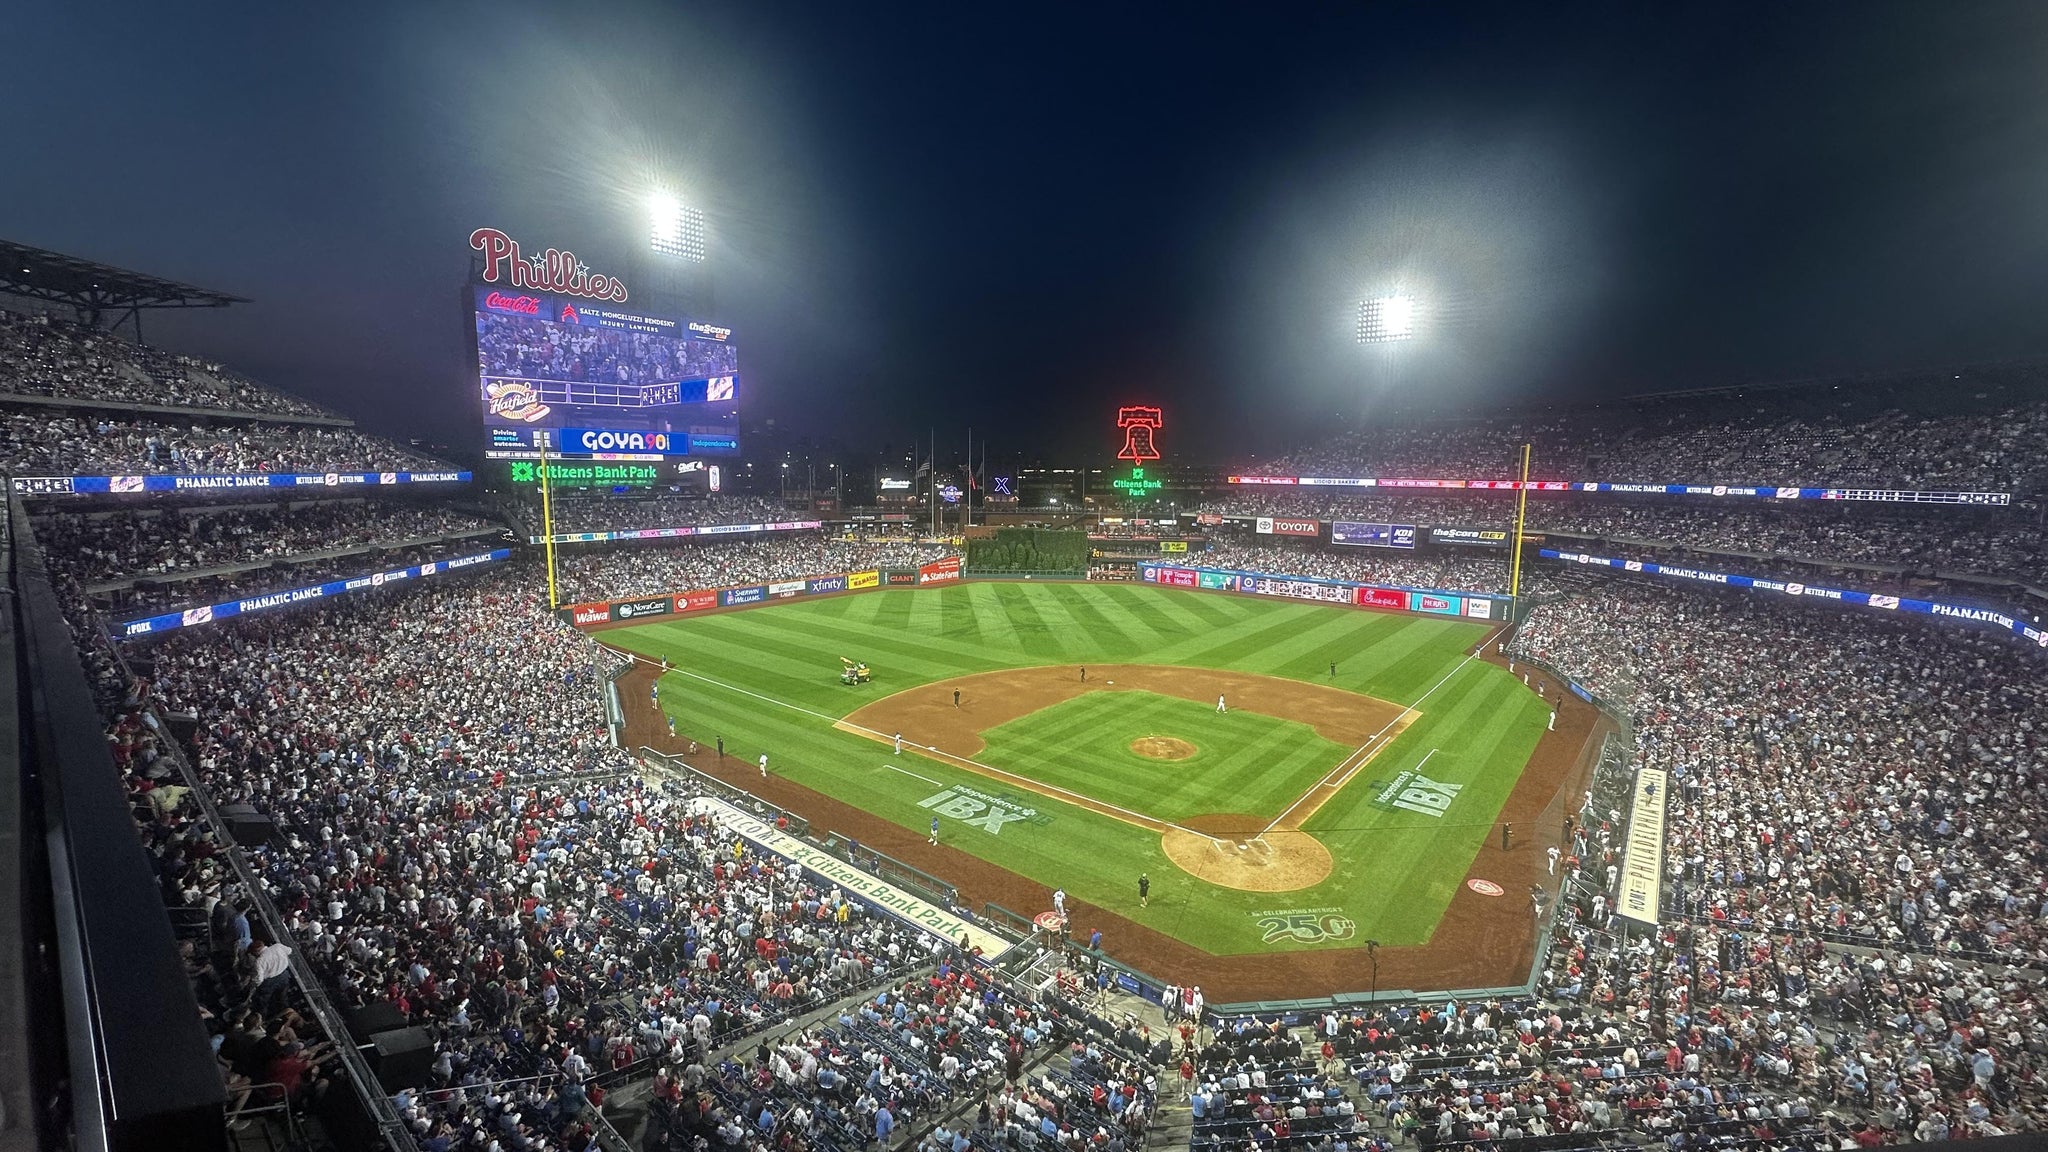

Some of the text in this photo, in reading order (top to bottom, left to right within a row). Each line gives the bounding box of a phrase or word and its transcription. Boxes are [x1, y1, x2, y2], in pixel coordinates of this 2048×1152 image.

[470, 228, 627, 302] Phillies
[579, 307, 675, 328] SALTZ MONGELUZZI BENDESKY
[600, 319, 659, 333] INJURY LAWYERS
[688, 322, 731, 336] theScore
[654, 390, 660, 400] H
[668, 388, 672, 399] E
[490, 389, 537, 414] Hatfield
[582, 431, 643, 450] GOYA
[645, 433, 666, 450] 90
[536, 465, 657, 478] Citizens Bank Park
[34, 482, 43, 490] H
[54, 482, 61, 490] E
[176, 476, 270, 488] PHANATIC DANCE
[1113, 480, 1162, 488] Citizens Bank
[1129, 488, 1145, 496] Park
[1275, 522, 1315, 532] TOYOTA
[1433, 528, 1480, 538] theScore
[1174, 572, 1194, 580] Temple
[1658, 566, 1728, 583] PHANATIC DANCE
[735, 588, 760, 596] SHERWIN
[812, 578, 842, 592] xfinity
[240, 587, 323, 612] PHANATIC DANCE
[633, 601, 665, 612] NovaCare
[576, 612, 608, 623] Wawa
[1932, 604, 1999, 623] PHANATIC
[131, 622, 152, 635] PORK
[952, 784, 1022, 811] Independence
[1392, 774, 1464, 818] IBX
[916, 790, 1026, 835] IBX
[716, 807, 786, 845] WELCOME
[1629, 808, 1660, 882] PHILADELPHIA
[806, 855, 964, 938] Citizens Bank Park
[1628, 888, 1646, 912] HOME
[1263, 908, 1308, 916] CELEBRATING
